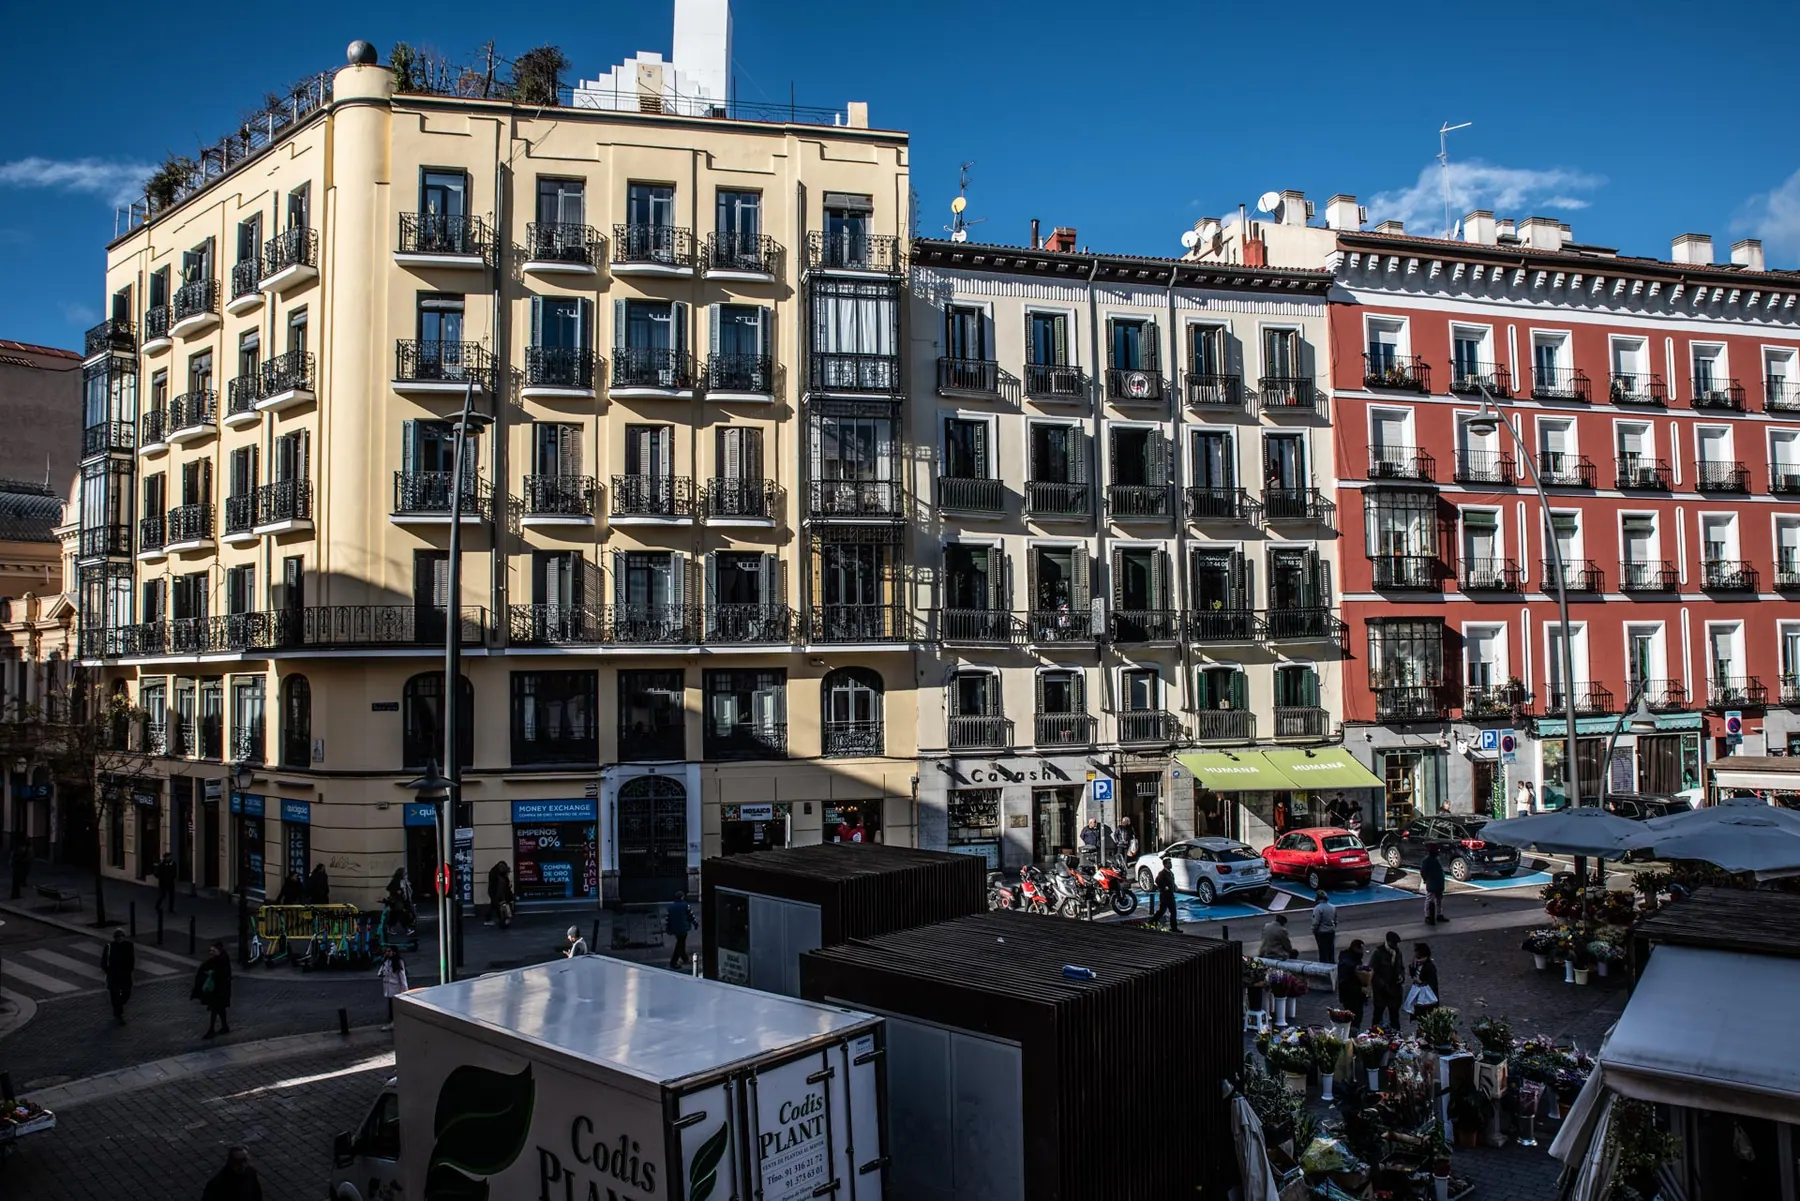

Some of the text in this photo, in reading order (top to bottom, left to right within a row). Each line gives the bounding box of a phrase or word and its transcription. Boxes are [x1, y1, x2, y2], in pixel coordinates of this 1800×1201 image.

[1484, 732, 1494, 748] P
[1204, 766, 1260, 774] HUMANA
[1292, 762, 1346, 772] HUMANA
[1096, 781, 1108, 799] P
[517, 826, 557, 836] EMPEÑOS
[538, 836, 560, 848] 0%
[779, 1093, 824, 1125] Codis
[759, 1114, 824, 1160] PLANT
[572, 1115, 656, 1194] Codis
[784, 1168, 792, 1178] 91
[794, 1161, 806, 1173] 316
[806, 1158, 814, 1168] 21
[786, 1180, 792, 1188] 91
[794, 1173, 806, 1185] 373
[816, 1165, 823, 1174] 01
